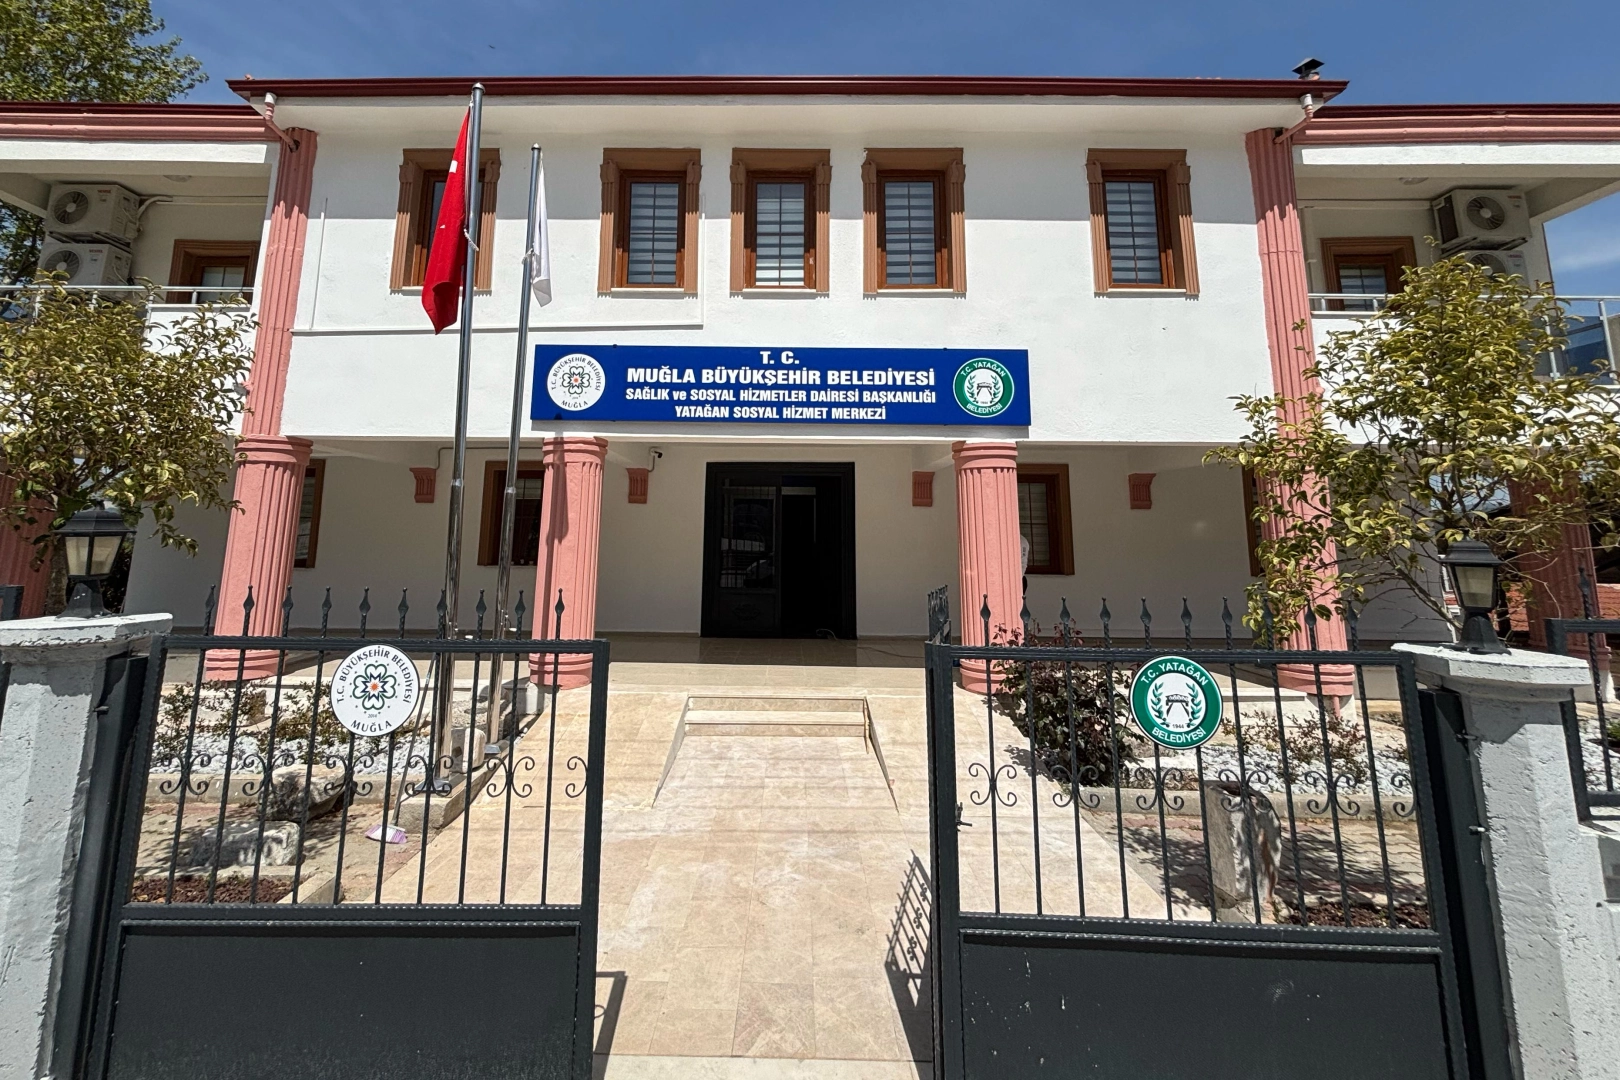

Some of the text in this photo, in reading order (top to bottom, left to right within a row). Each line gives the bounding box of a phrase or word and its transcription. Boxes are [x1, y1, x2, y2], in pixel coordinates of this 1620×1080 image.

[626, 365, 935, 387] MUĞLA BÜYÜKŞEHİR BELEDİYESİ
[972, 361, 1007, 378] YATAĞAN
[625, 386, 936, 404] SAĞLIK ve SOSYAL HİZMETLER DAİRESİ BAŞKANLIĞI
[561, 400, 589, 409] MUĞLA
[674, 403, 887, 420] YATAĞAN SOSYAL HİZMET MERKEZİ
[338, 647, 391, 682] BÜYÜKŞEHİR
[1140, 662, 1209, 686] T.C. YATAĞAN
[336, 685, 345, 704] T.C.
[350, 719, 393, 733] MUĞLA
[1151, 726, 1207, 744] BELEDİYESİ
